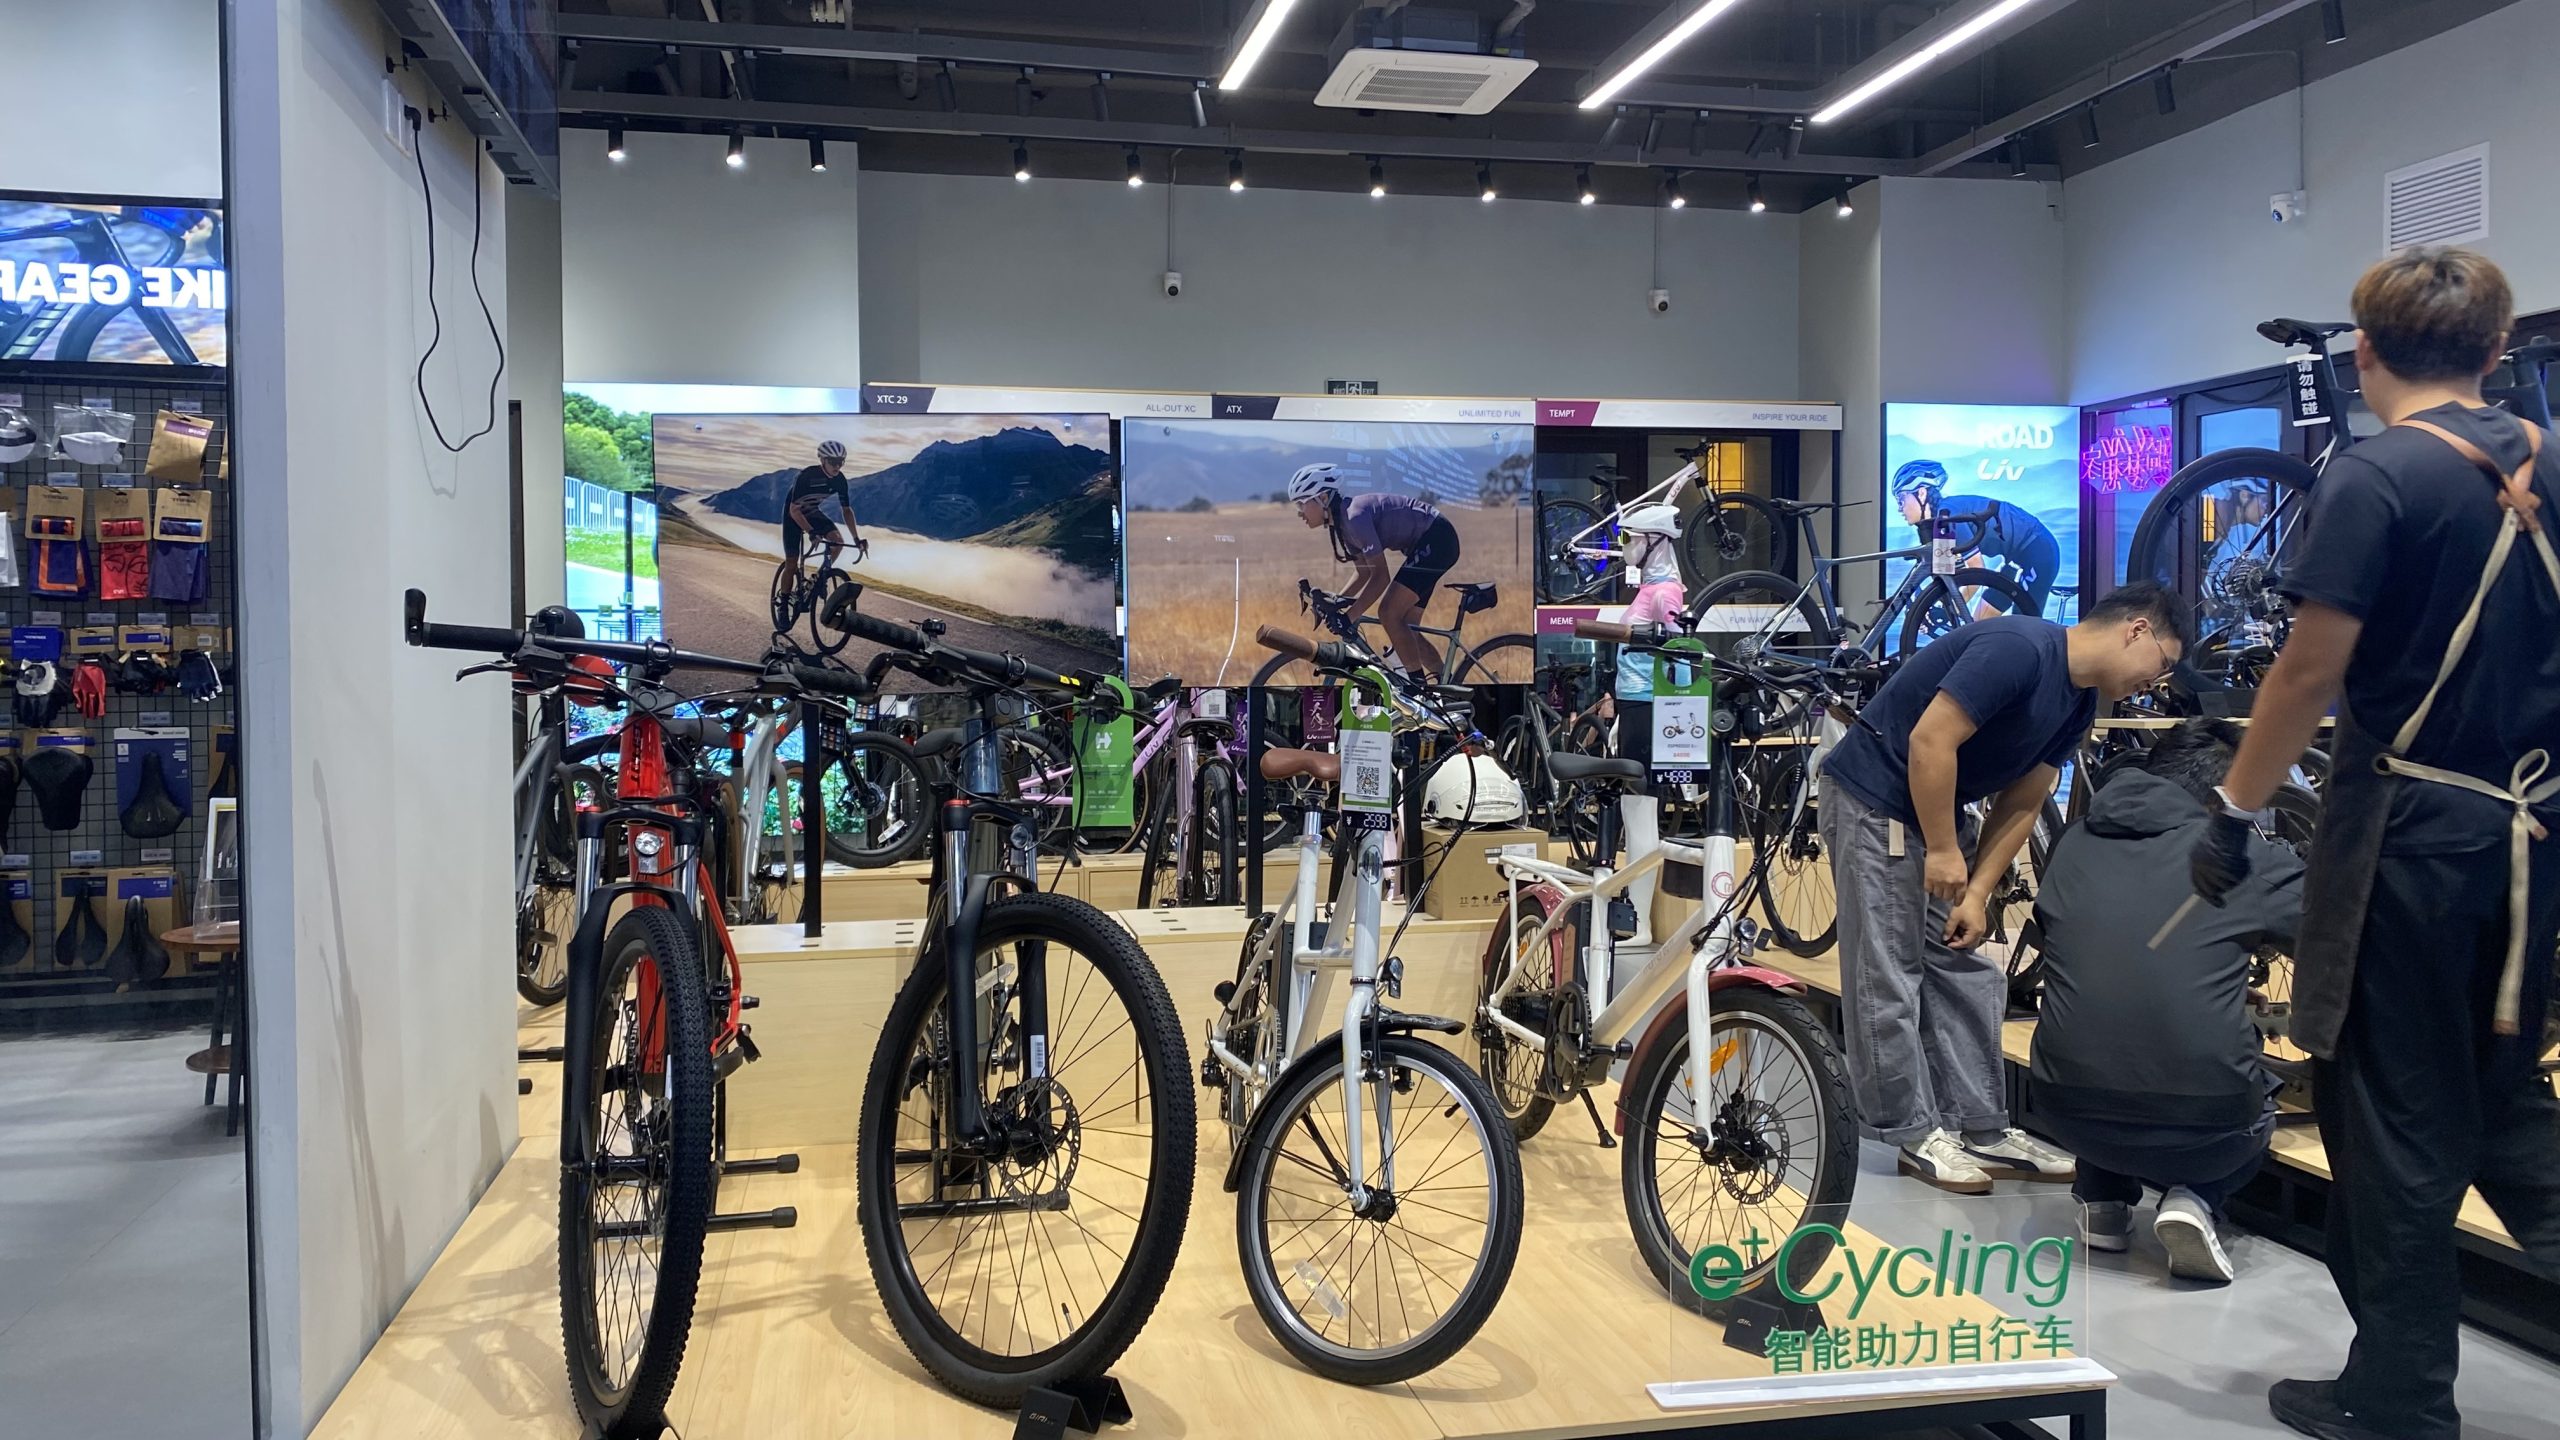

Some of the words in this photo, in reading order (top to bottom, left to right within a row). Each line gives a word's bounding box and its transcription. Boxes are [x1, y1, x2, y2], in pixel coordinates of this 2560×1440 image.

[877, 394, 894, 405] XTC
[896, 395, 909, 405] 29
[1146, 403, 1183, 413] ALL-OUT
[1184, 405, 1197, 414] XC
[1226, 405, 1243, 414] ATX
[1458, 409, 1502, 418] UNLIMITED
[1504, 410, 1521, 419] FUN
[1549, 409, 1575, 418] TEMPT
[1752, 412, 1783, 421] INSPIRE
[1785, 413, 1807, 422] YOUR
[1809, 413, 1828, 422] RIDE
[1979, 423, 2054, 450] ROAD
[1976, 458, 2026, 481] Liv
[1550, 616, 1574, 625] MEME
[1144, 740, 1160, 758] Liv
[1363, 812, 1388, 829] 2598
[1775, 1222, 2075, 1320] Cycling
[1764, 1313, 2075, 1375] 智能助力自行车
